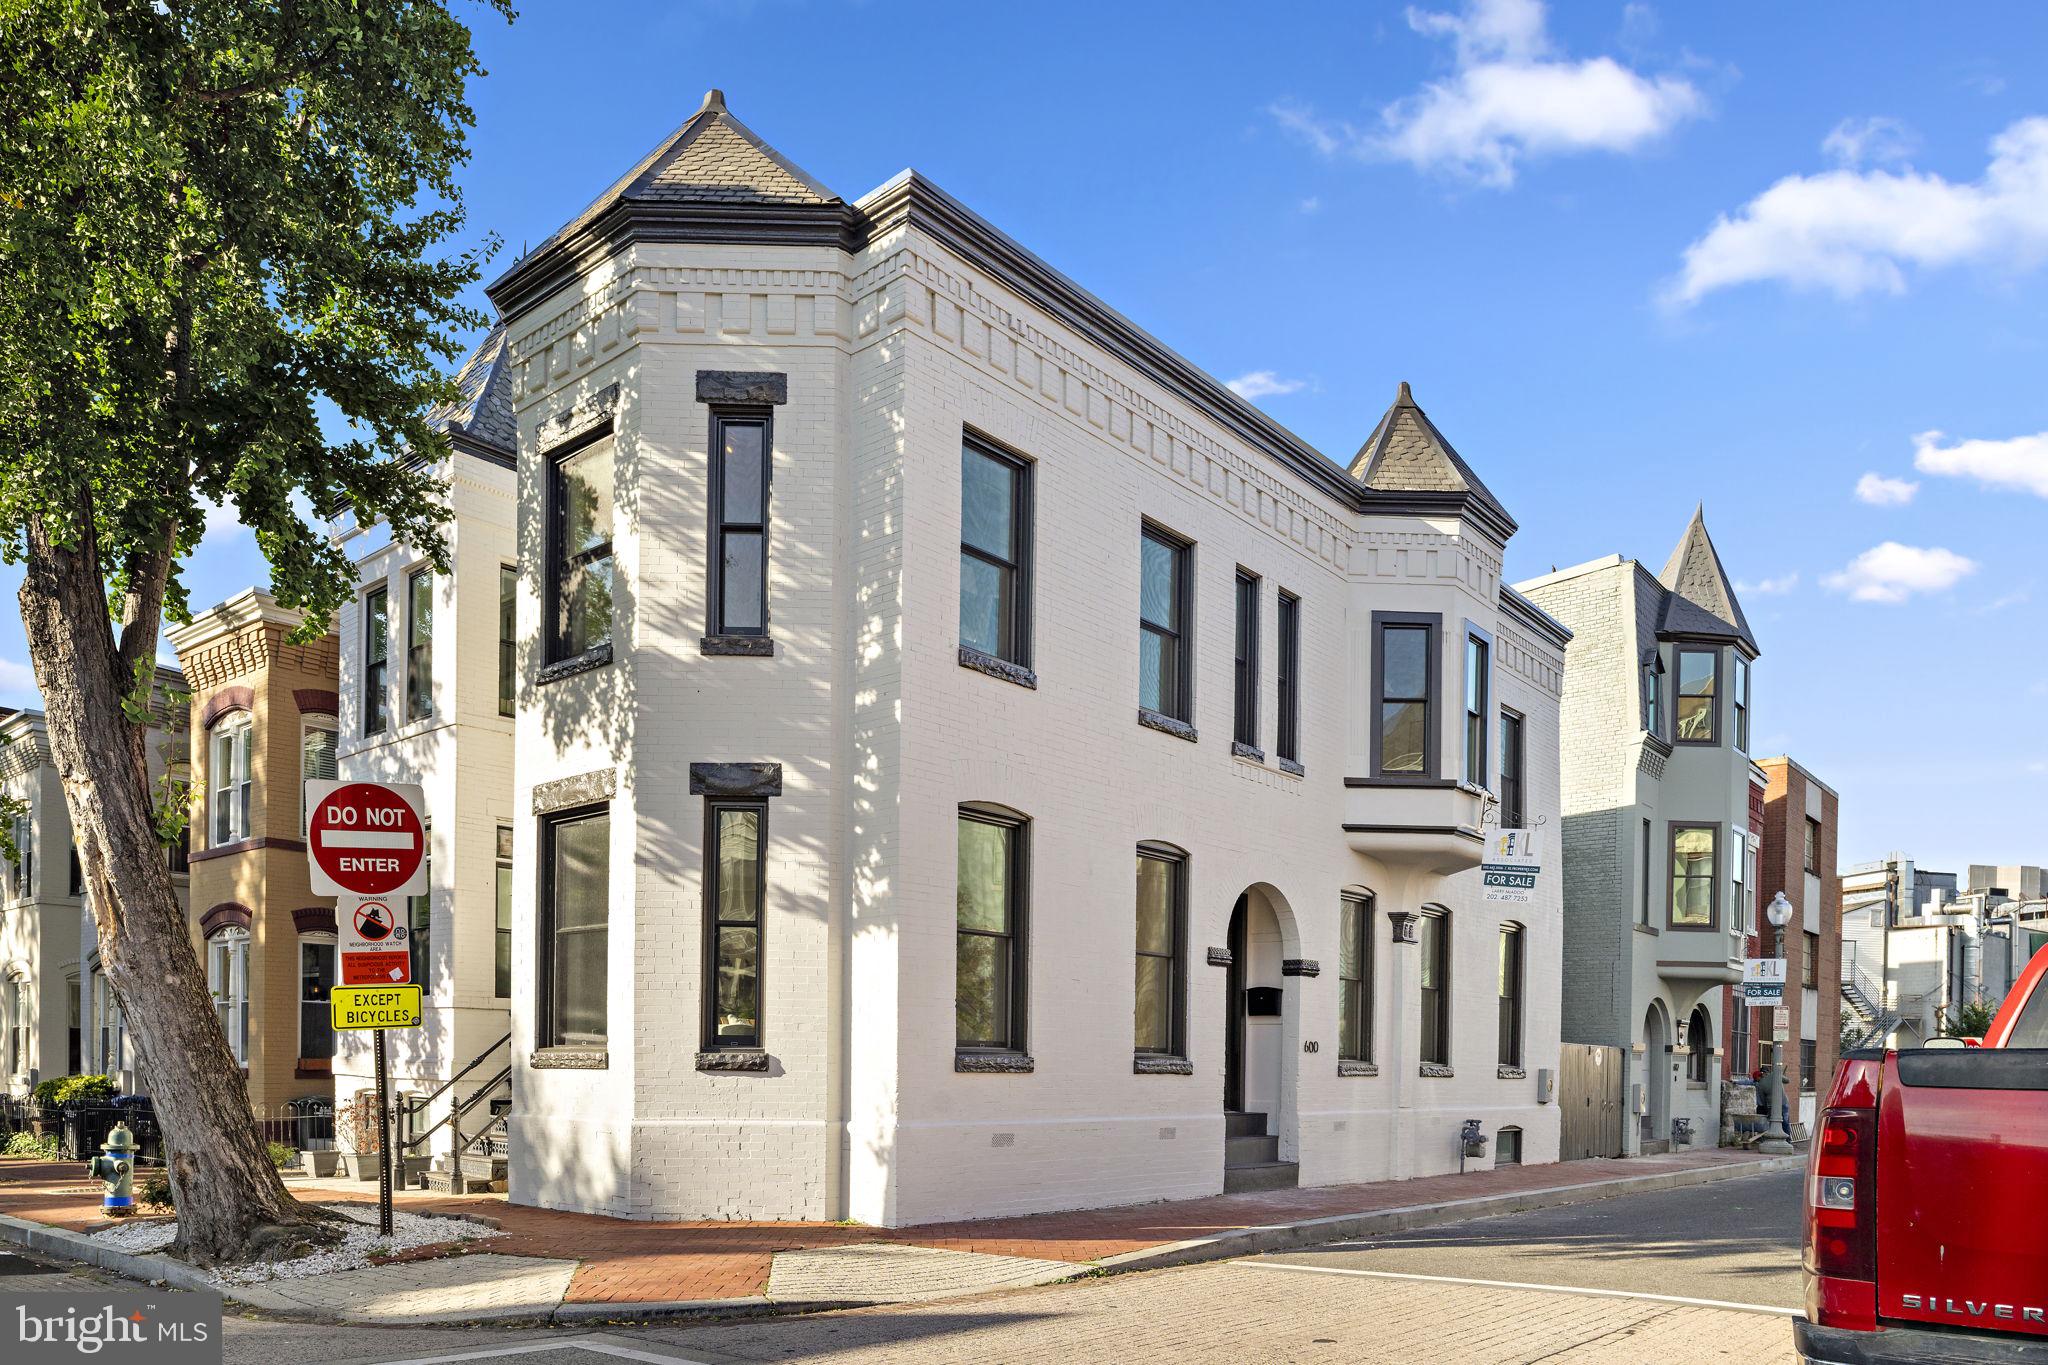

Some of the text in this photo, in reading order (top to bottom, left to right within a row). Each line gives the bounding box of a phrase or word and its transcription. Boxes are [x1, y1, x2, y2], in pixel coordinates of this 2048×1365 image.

[327, 806, 405, 827] DO NOT
[340, 857, 400, 872] ENTER
[1487, 874, 1532, 886] FOR SALE
[354, 993, 401, 1007] EXCEPT
[347, 1010, 409, 1024] BICYCLES
[1304, 1041, 1319, 1053] 600
[1902, 1294, 2046, 1323] SILVER
